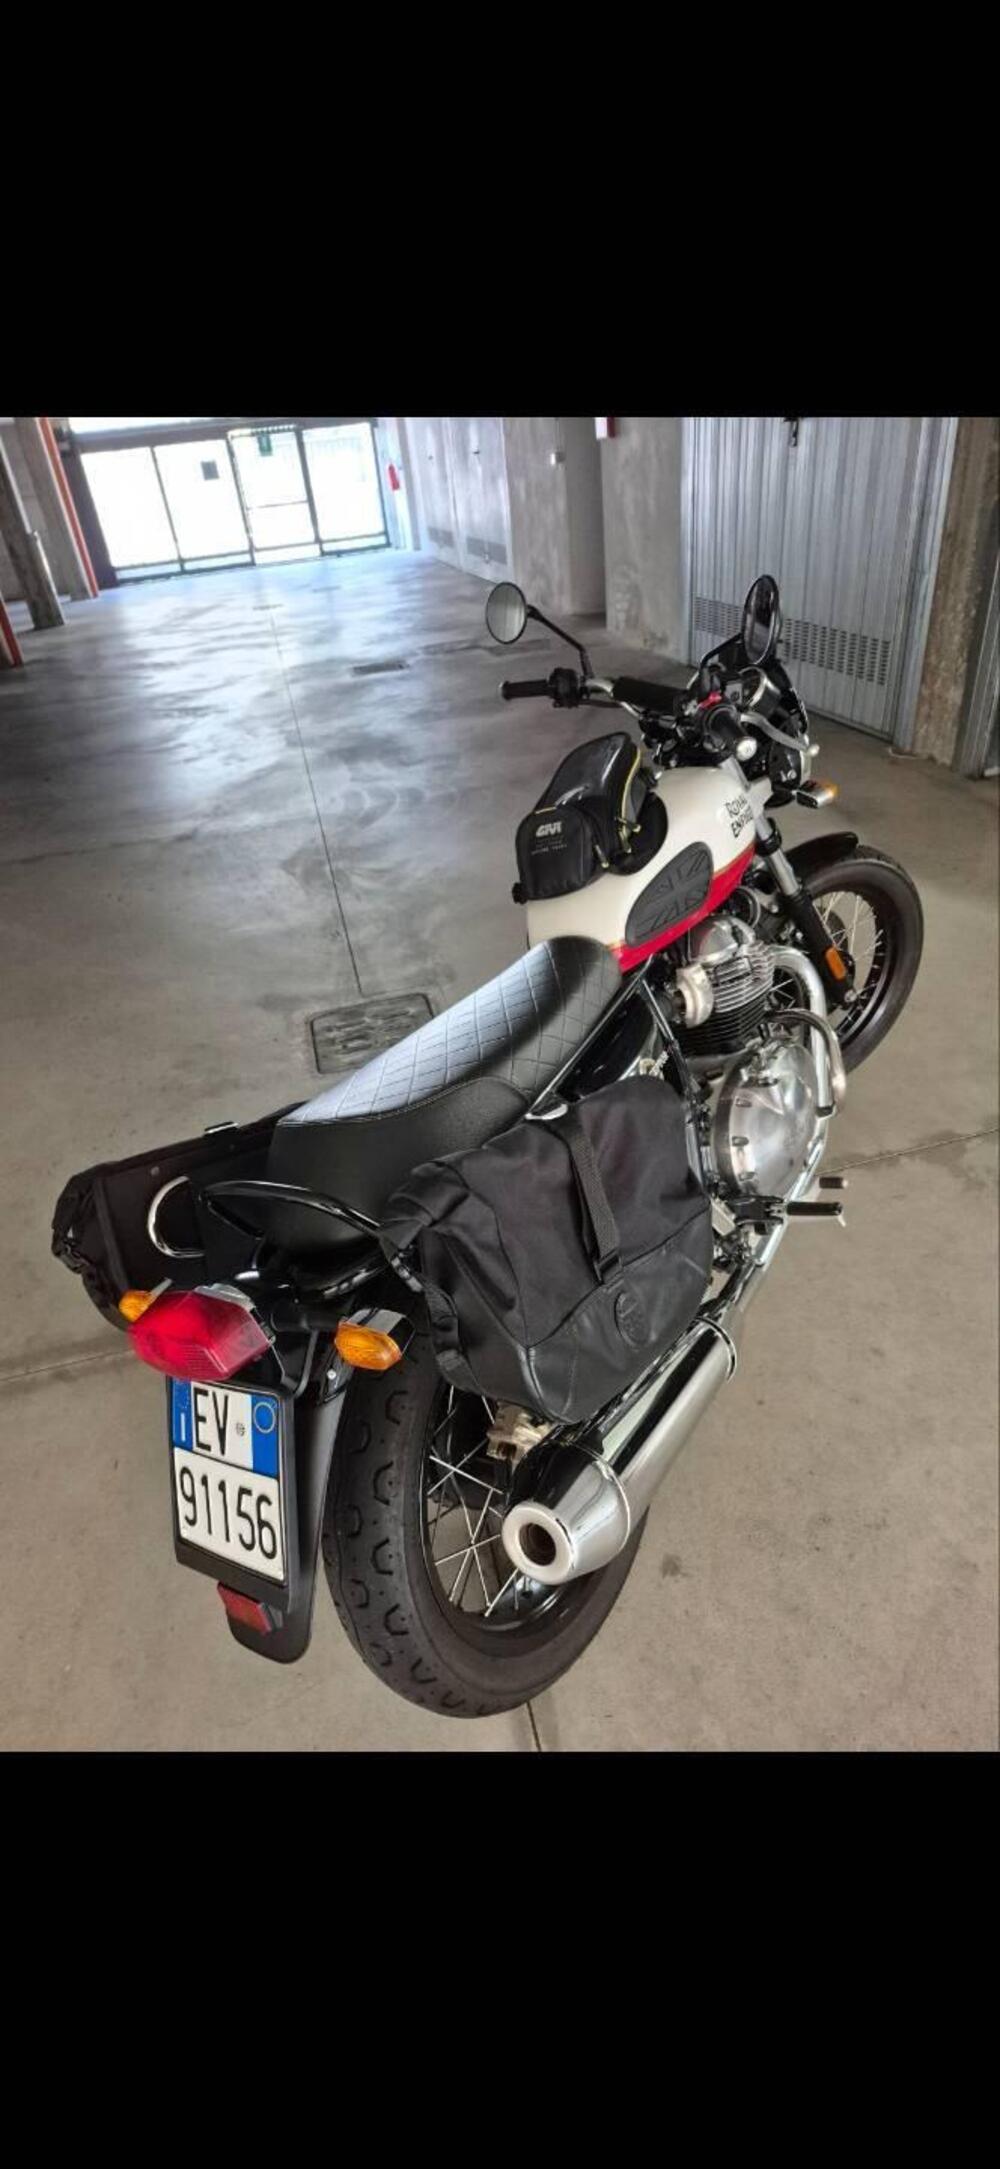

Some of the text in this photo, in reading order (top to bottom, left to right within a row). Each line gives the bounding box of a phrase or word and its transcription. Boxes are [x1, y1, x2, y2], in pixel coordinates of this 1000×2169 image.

[536, 821, 562, 837] GIVI
[193, 1386, 229, 1457] EV
[179, 1466, 277, 1560] 91156
